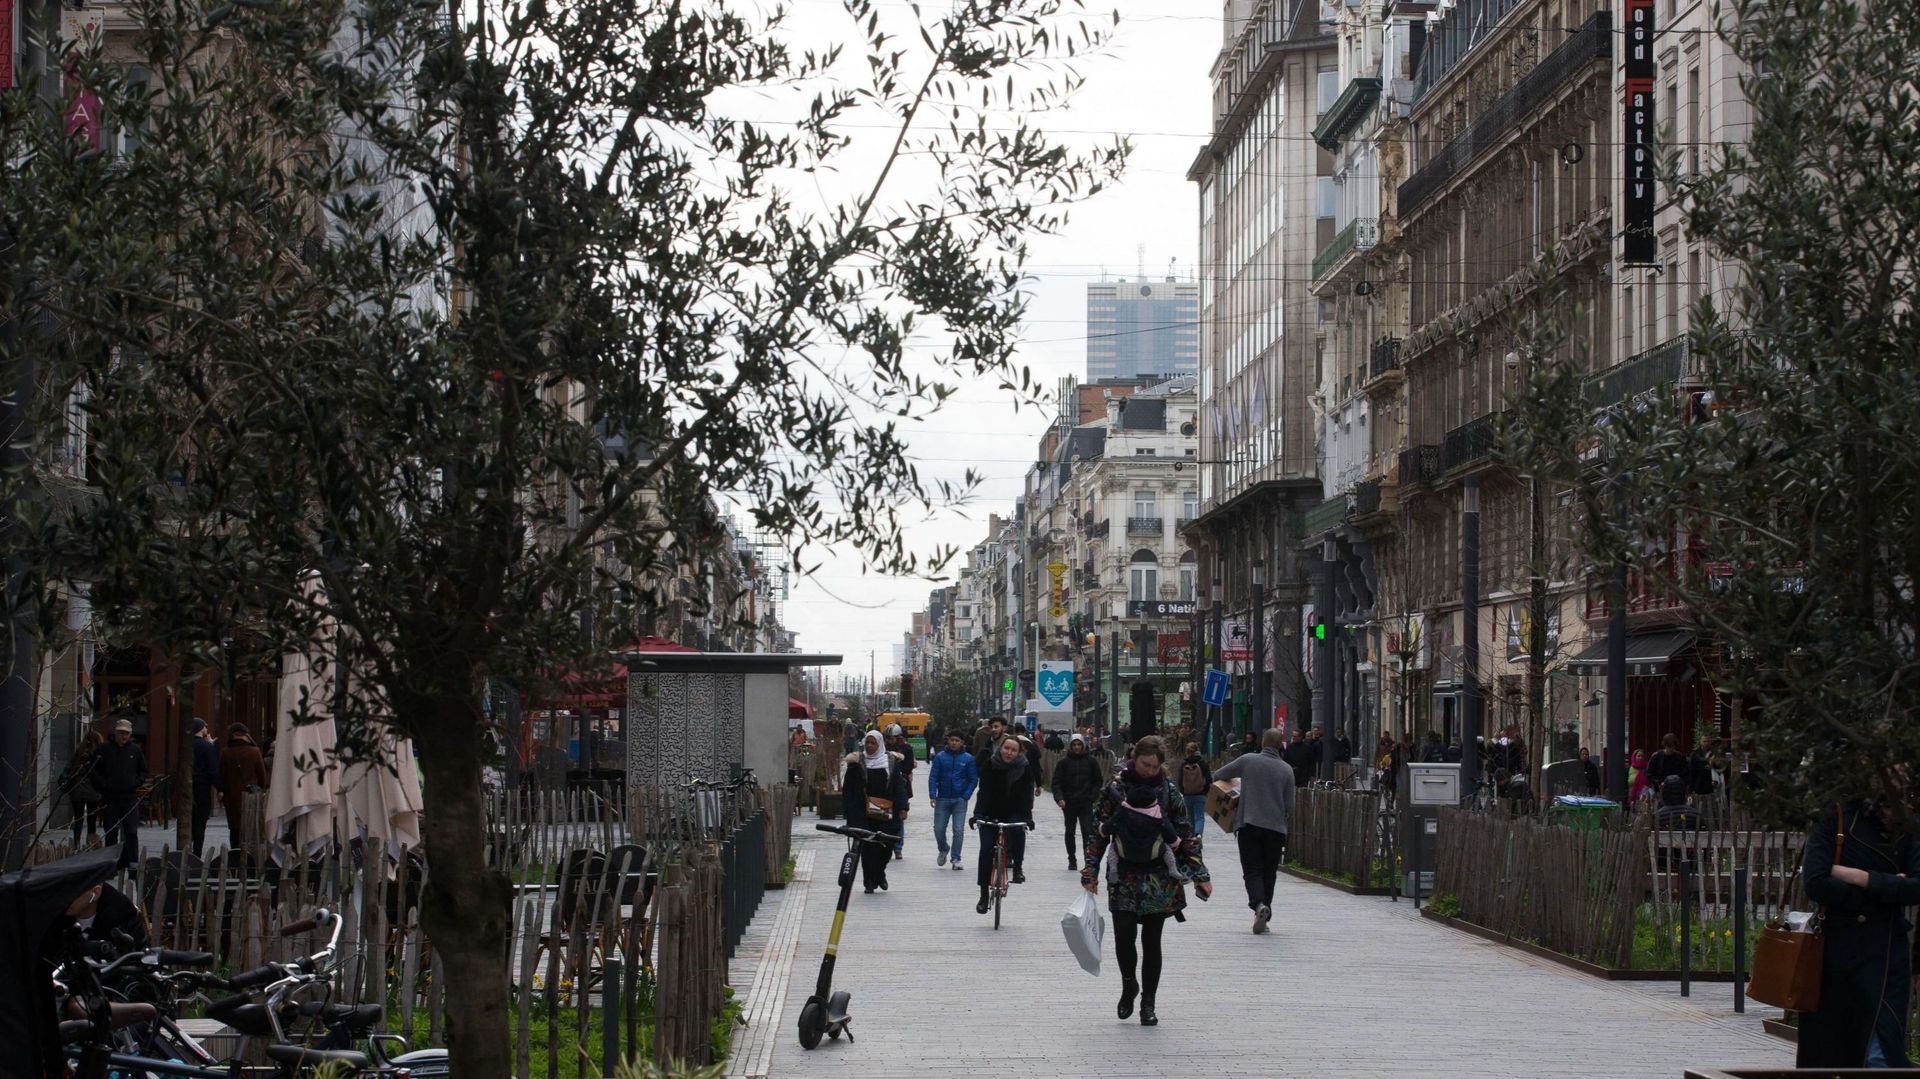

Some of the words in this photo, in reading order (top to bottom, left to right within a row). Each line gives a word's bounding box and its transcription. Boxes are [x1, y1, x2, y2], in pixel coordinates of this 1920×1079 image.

[1626, 0, 1653, 60] Food
[1626, 78, 1653, 199] Factory
[1157, 604, 1166, 613] 6
[842, 857, 853, 875] dott
